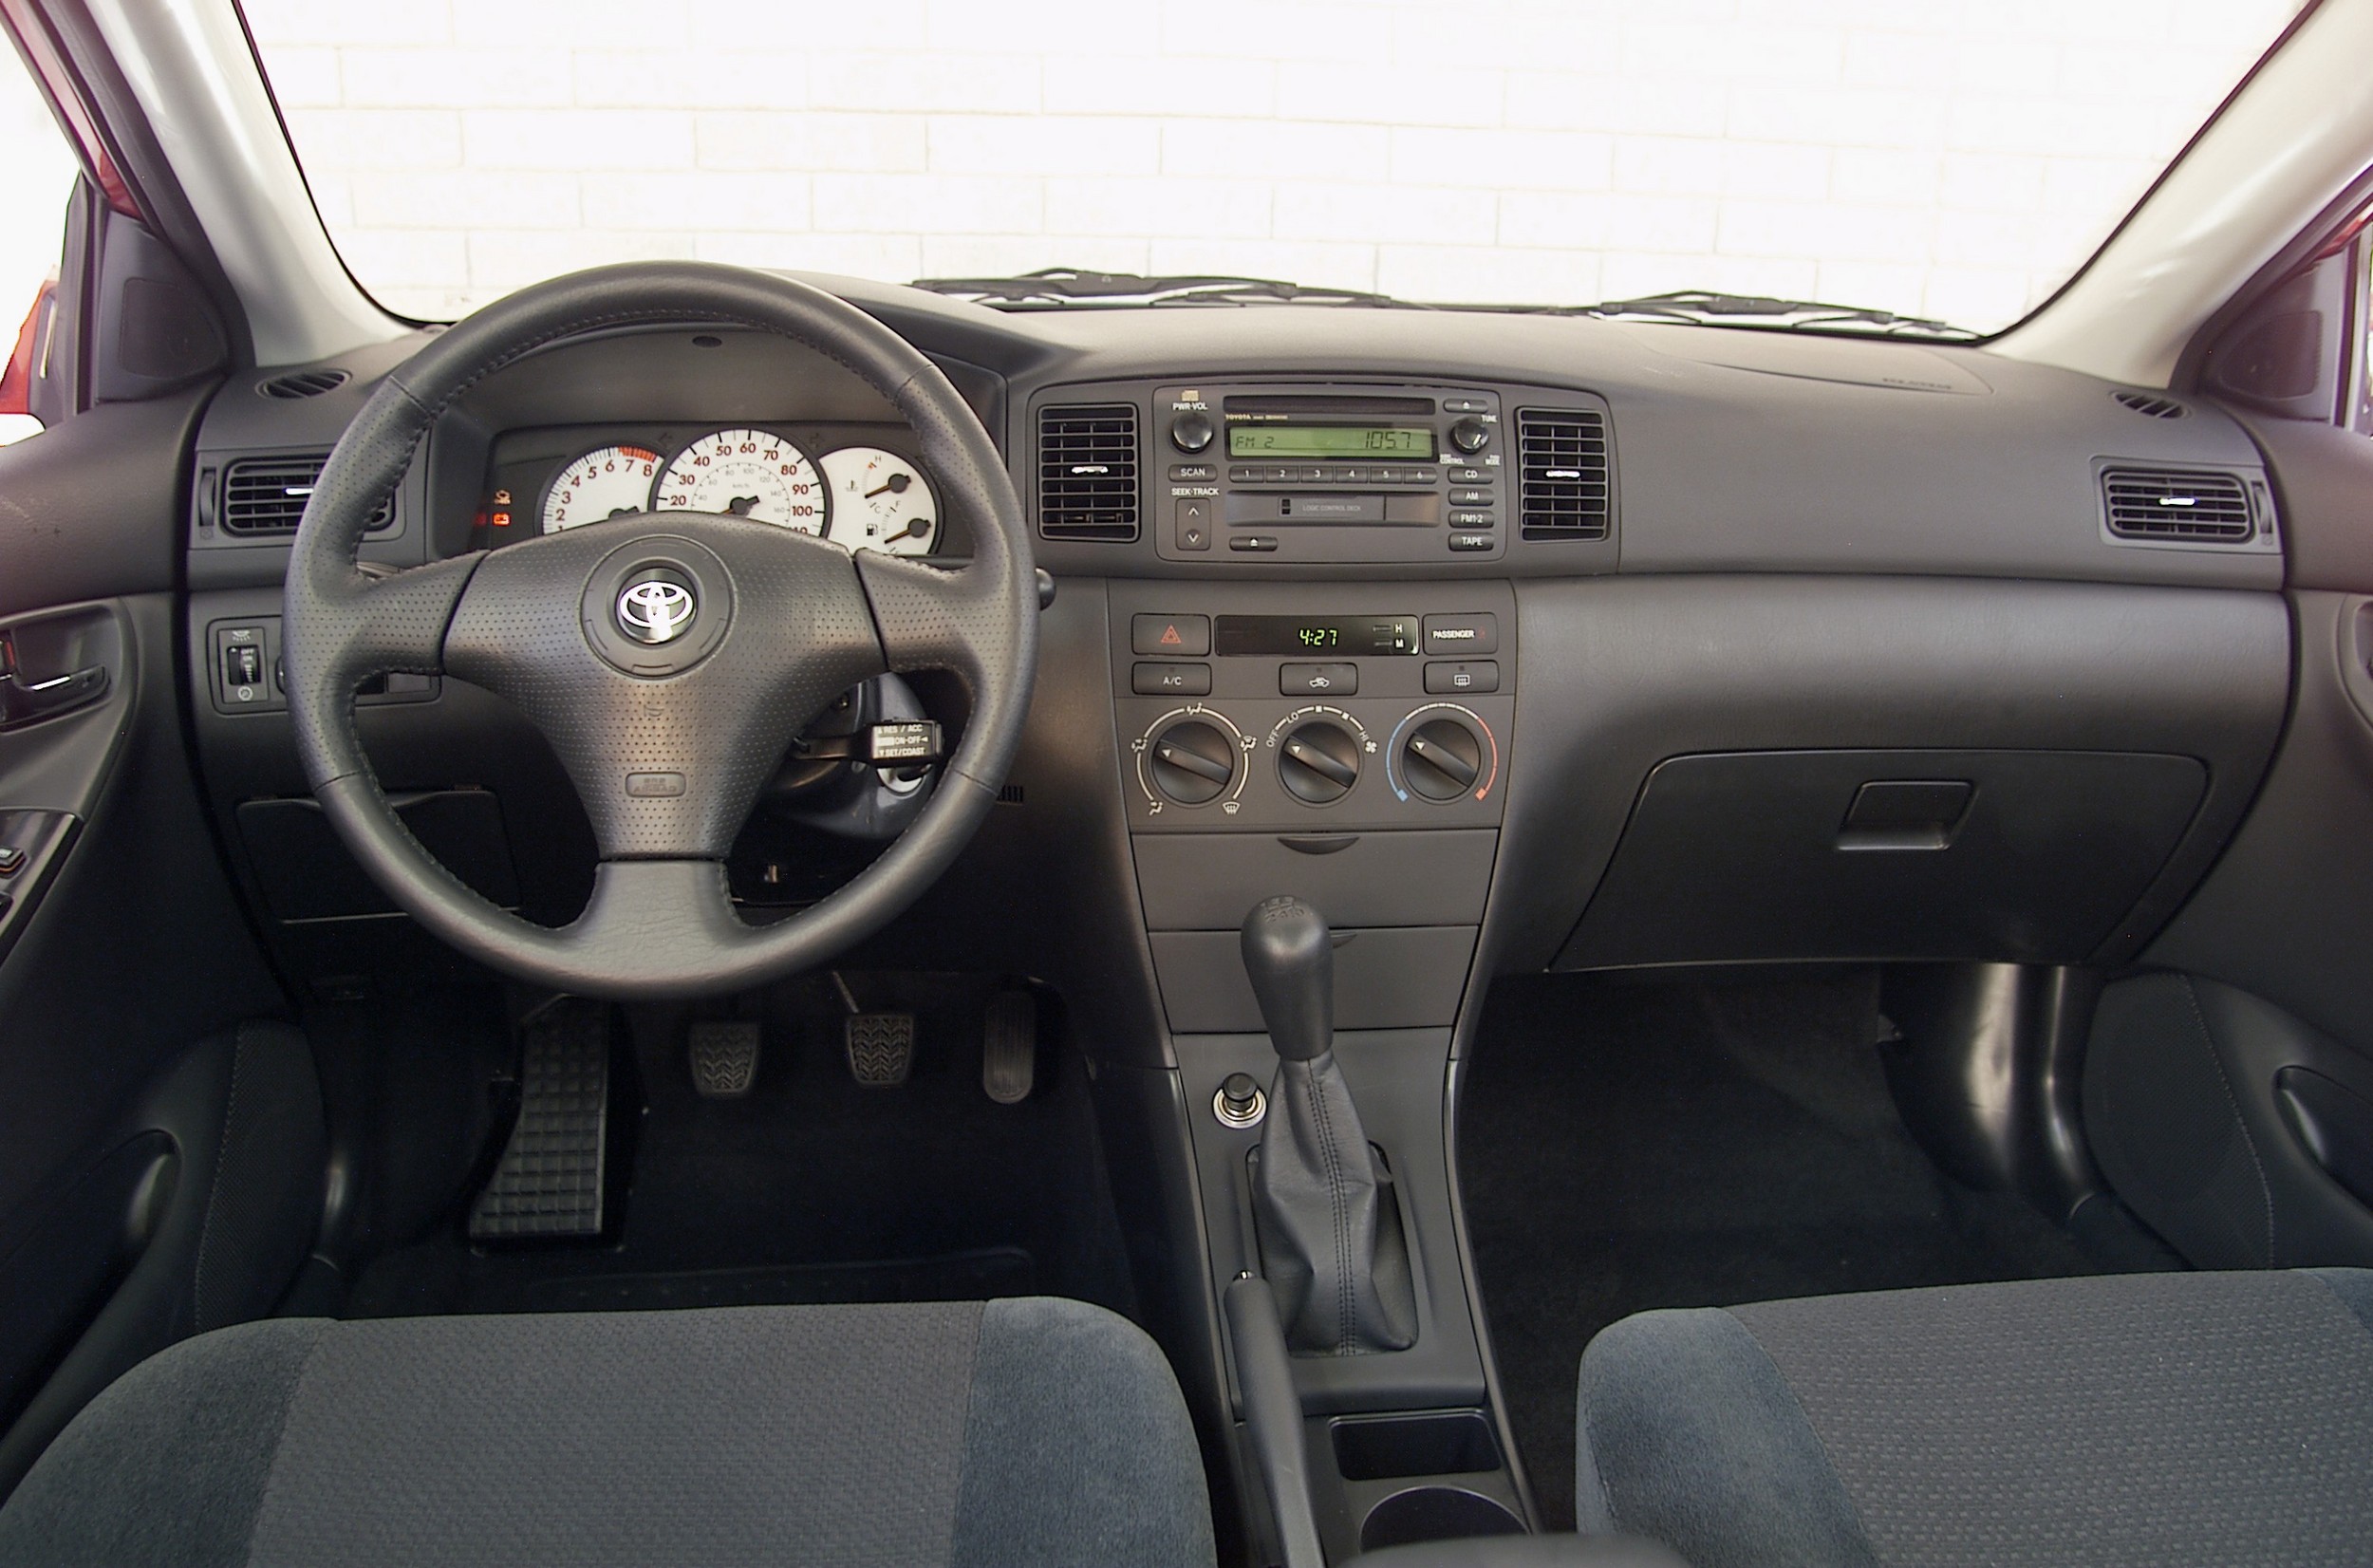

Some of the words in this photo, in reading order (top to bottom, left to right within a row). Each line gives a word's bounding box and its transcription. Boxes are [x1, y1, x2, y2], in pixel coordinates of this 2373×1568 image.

[739, 442, 756, 454] 60
[1235, 436, 1255, 449] FM
[1263, 436, 1274, 449] 2
[716, 445, 732, 457] 50
[763, 449, 778, 461] 70
[606, 459, 615, 473] 6
[626, 459, 634, 473] 7
[694, 456, 710, 467] 40
[588, 466, 597, 479] 5
[643, 464, 652, 476] 8
[781, 464, 797, 476] 80
[1181, 467, 1205, 477] SCAN
[1315, 469, 1321, 477] 3
[1417, 471, 1423, 479] 6
[1465, 470, 1478, 478] CD
[571, 476, 580, 488] 4
[679, 475, 695, 486] 30
[793, 483, 809, 495] 90
[562, 491, 571, 504] 3
[670, 495, 686, 506] 20
[1466, 492, 1479, 500] AM
[555, 508, 565, 521] 2
[792, 505, 813, 516] 100
[874, 505, 881, 513] C
[1462, 536, 1483, 546] TAPE
[1394, 624, 1403, 633] H
[1432, 629, 1474, 639] PASSENGER
[1299, 628, 1338, 646] 4:27
[1395, 639, 1404, 648] M
[1163, 676, 1182, 685] A/C
[1286, 712, 1299, 724] LO
[1266, 729, 1279, 748] OFF
[1358, 730, 1370, 742] HI
